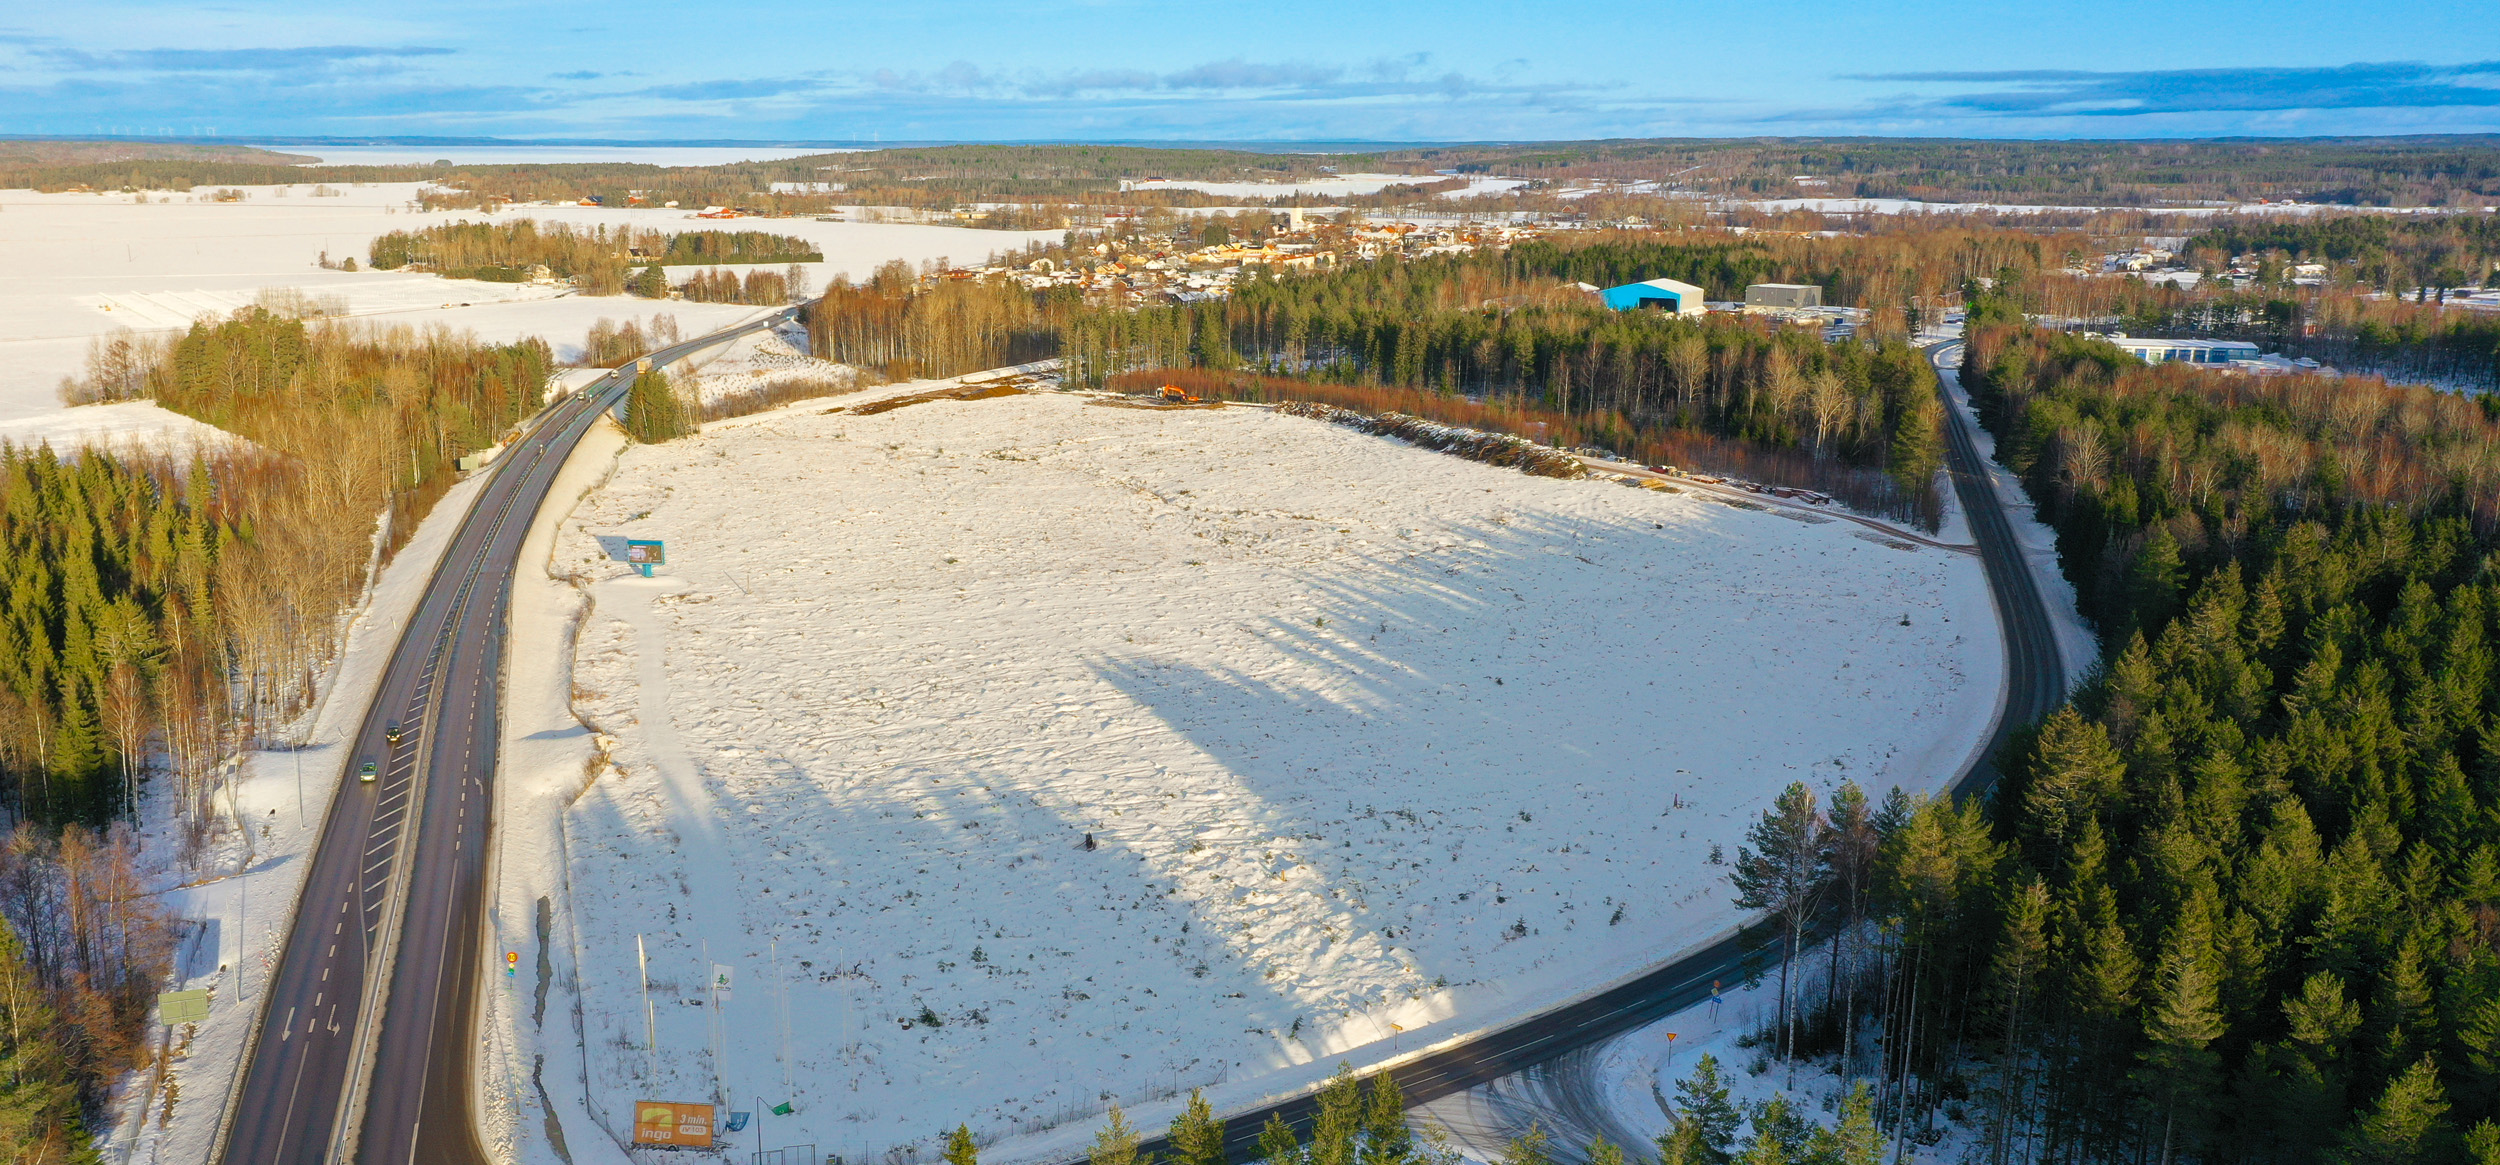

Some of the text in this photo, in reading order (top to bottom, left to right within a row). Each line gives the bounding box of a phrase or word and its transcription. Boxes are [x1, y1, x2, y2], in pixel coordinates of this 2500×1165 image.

[680, 1114, 708, 1125] 3 min.
[641, 1128, 672, 1142] ingo
